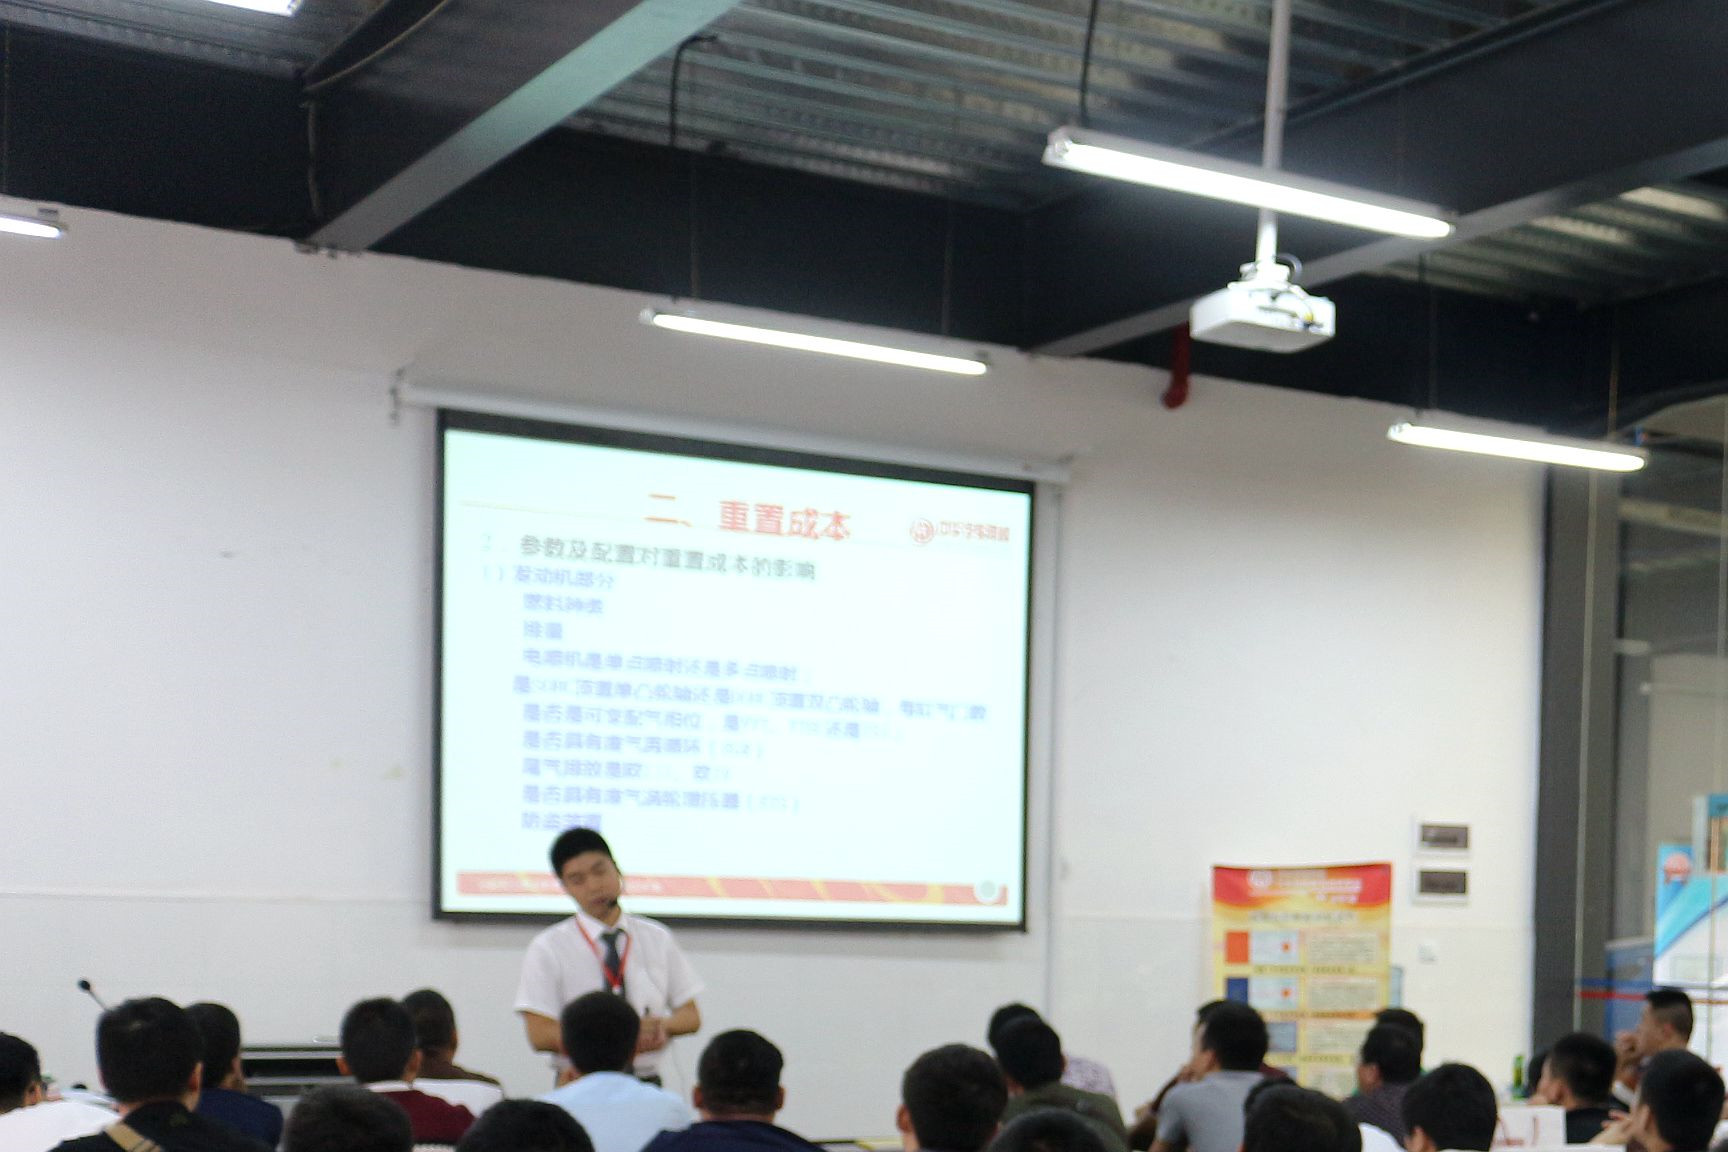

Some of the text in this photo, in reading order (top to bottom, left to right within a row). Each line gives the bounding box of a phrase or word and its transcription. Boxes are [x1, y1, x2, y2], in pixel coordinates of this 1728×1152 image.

[643, 492, 853, 543] 二、重置成本
